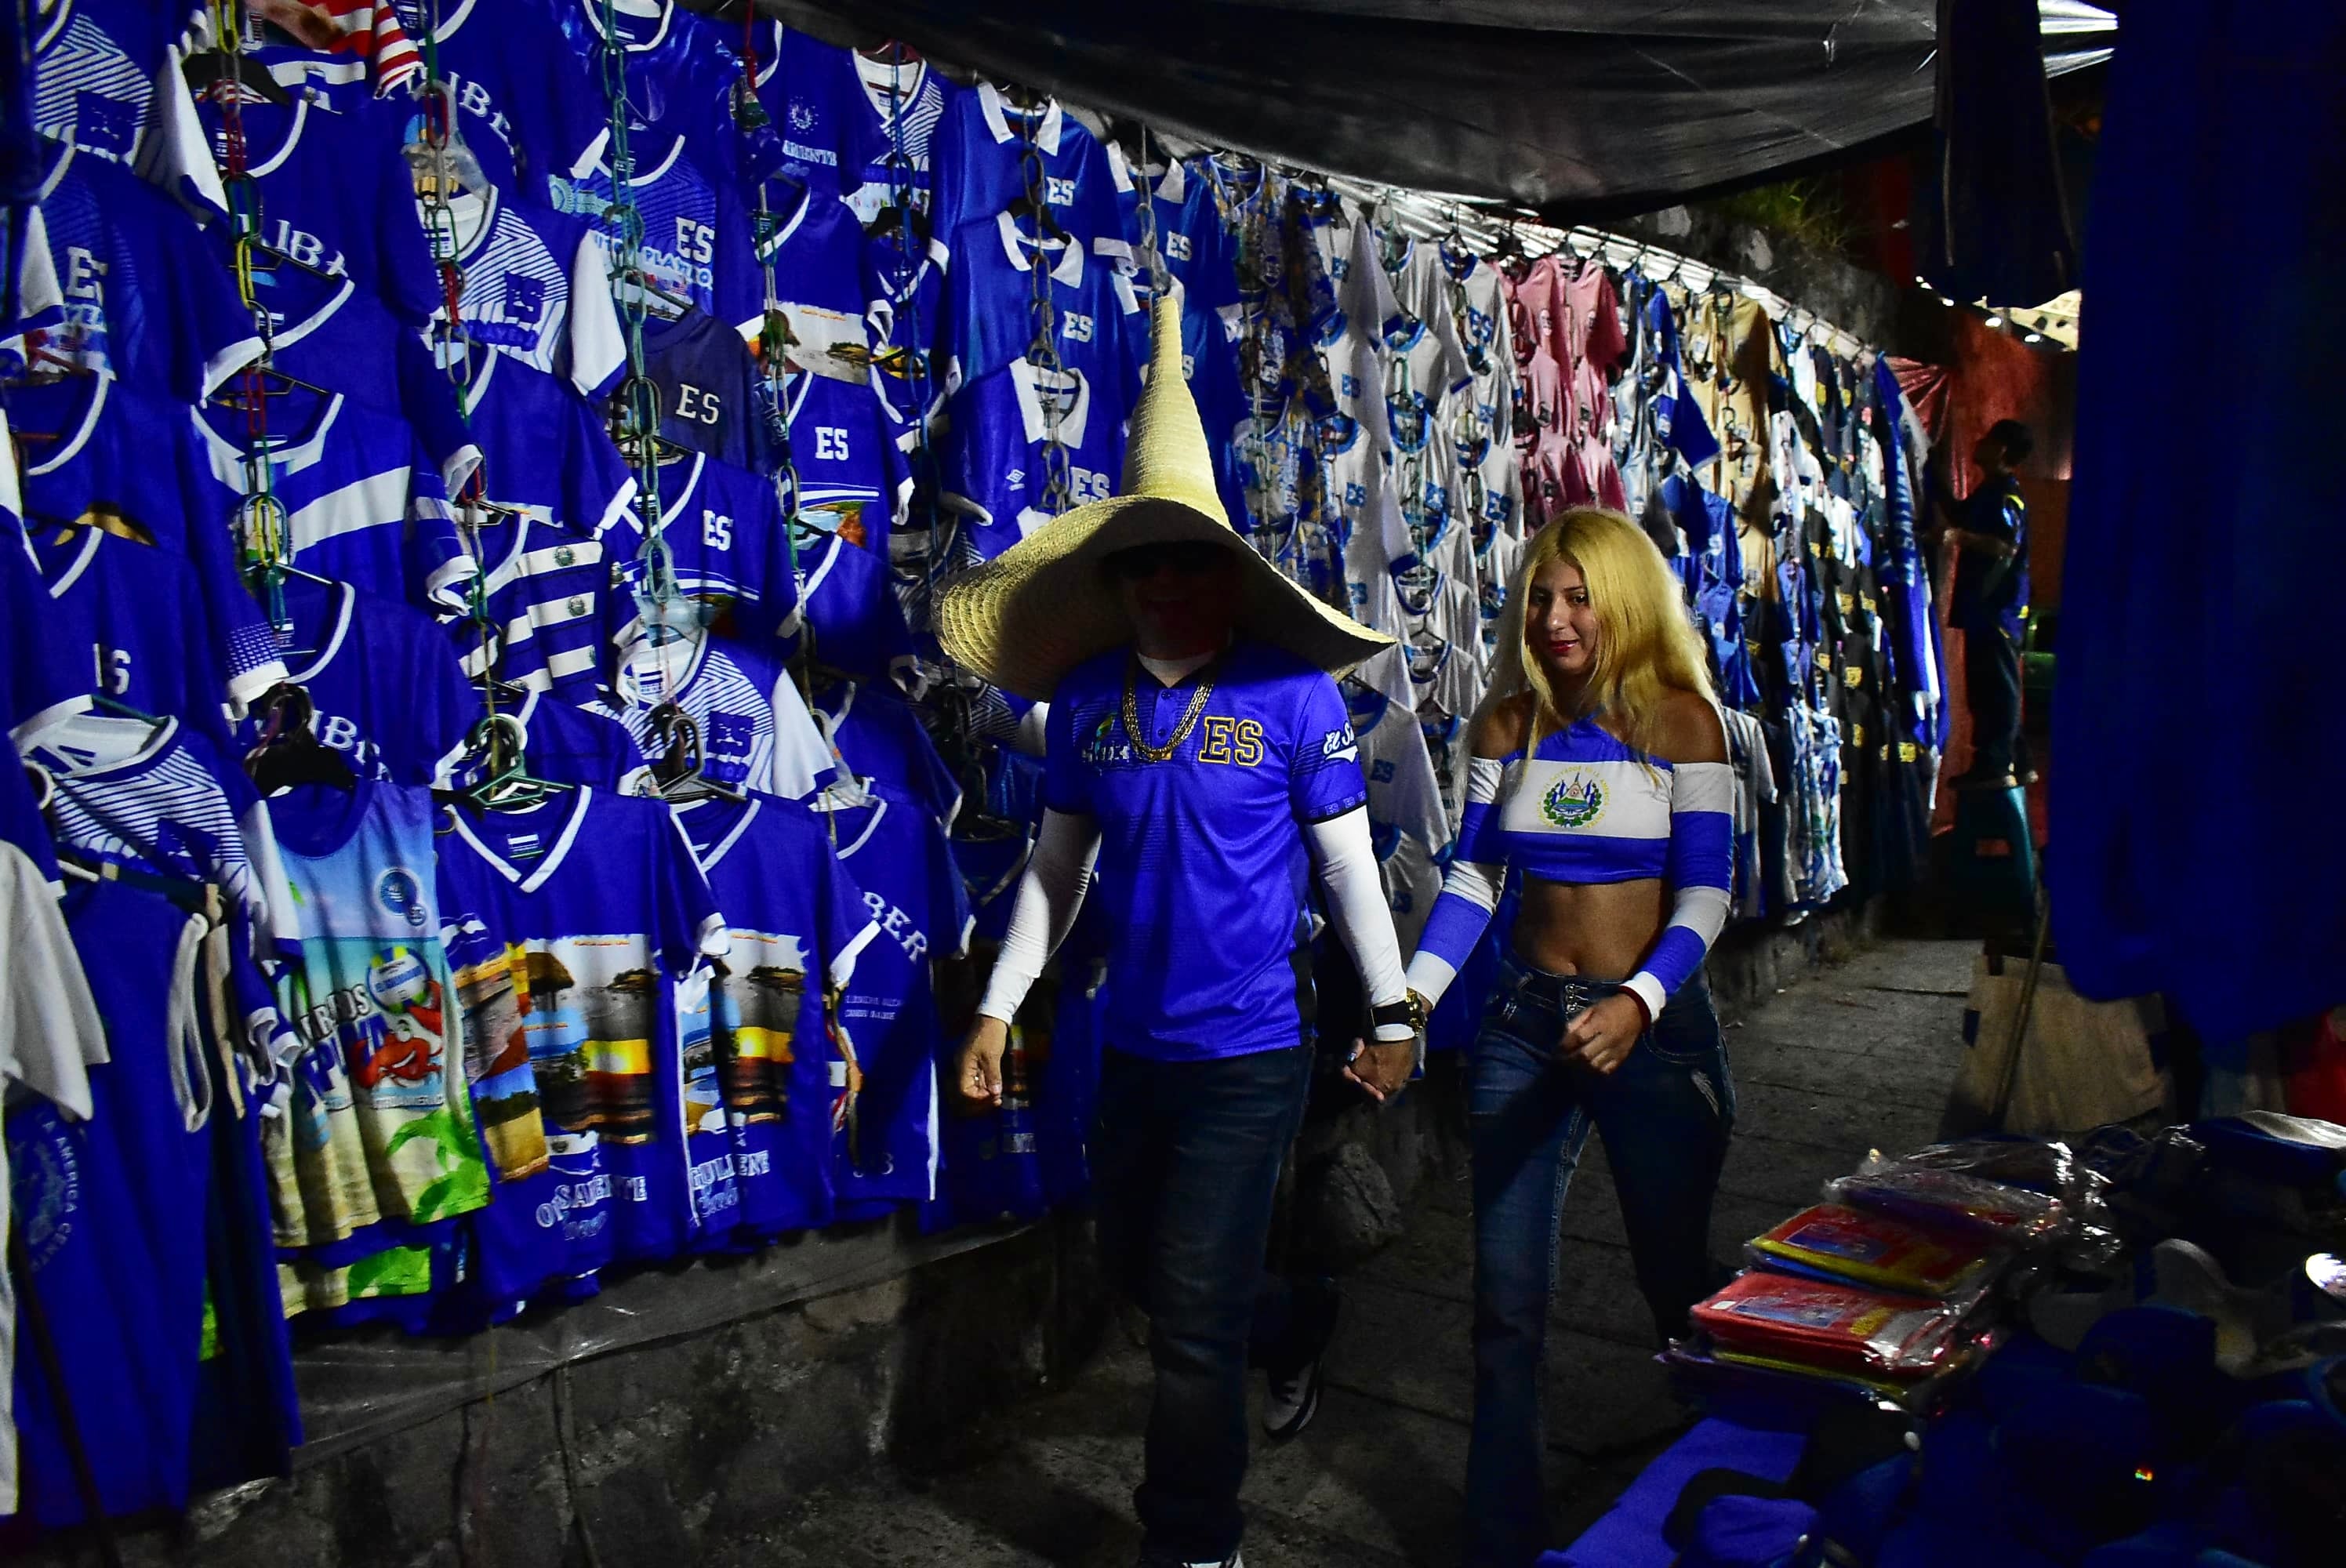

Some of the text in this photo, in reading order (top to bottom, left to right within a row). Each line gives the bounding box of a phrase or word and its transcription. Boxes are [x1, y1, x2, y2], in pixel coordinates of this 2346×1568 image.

[1048, 176, 1075, 207] ES
[676, 216, 715, 264] ES
[1167, 231, 1193, 262] ES
[1062, 310, 1093, 343] ES
[675, 383, 721, 426] ES
[815, 426, 850, 461] ES
[1069, 466, 1110, 506] ES
[702, 510, 735, 552] ES
[1198, 716, 1263, 767] ES
[1323, 729, 1342, 755] El
